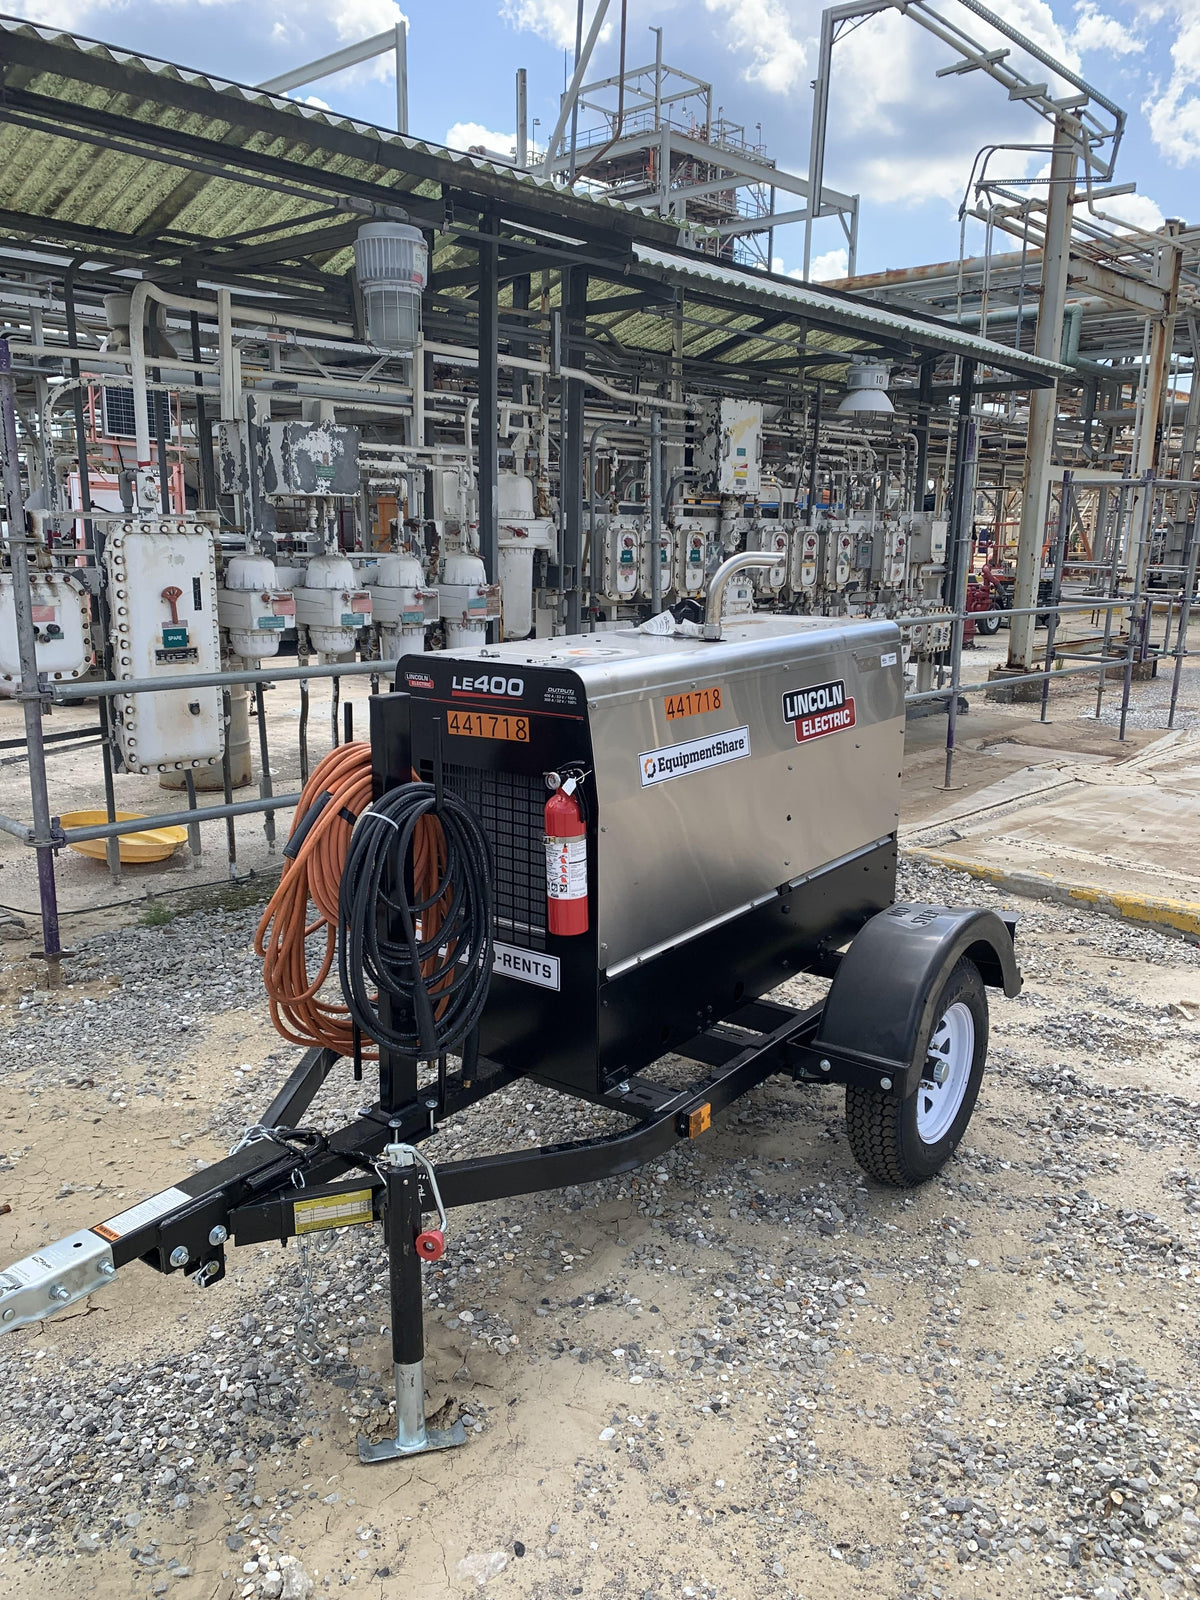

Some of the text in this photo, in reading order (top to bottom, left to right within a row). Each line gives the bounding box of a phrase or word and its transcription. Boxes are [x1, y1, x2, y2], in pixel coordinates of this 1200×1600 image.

[875, 375, 884, 384] 10
[406, 673, 429, 681] LINCOLN
[452, 675, 524, 696] LE400
[667, 688, 721, 719] 441718
[786, 684, 843, 718] LINCOLN
[449, 713, 528, 740] 441718
[802, 709, 850, 737] ELECTRIC
[658, 736, 745, 773] EquipmentShare
[887, 907, 911, 918] NO
[910, 909, 939, 925] STEP
